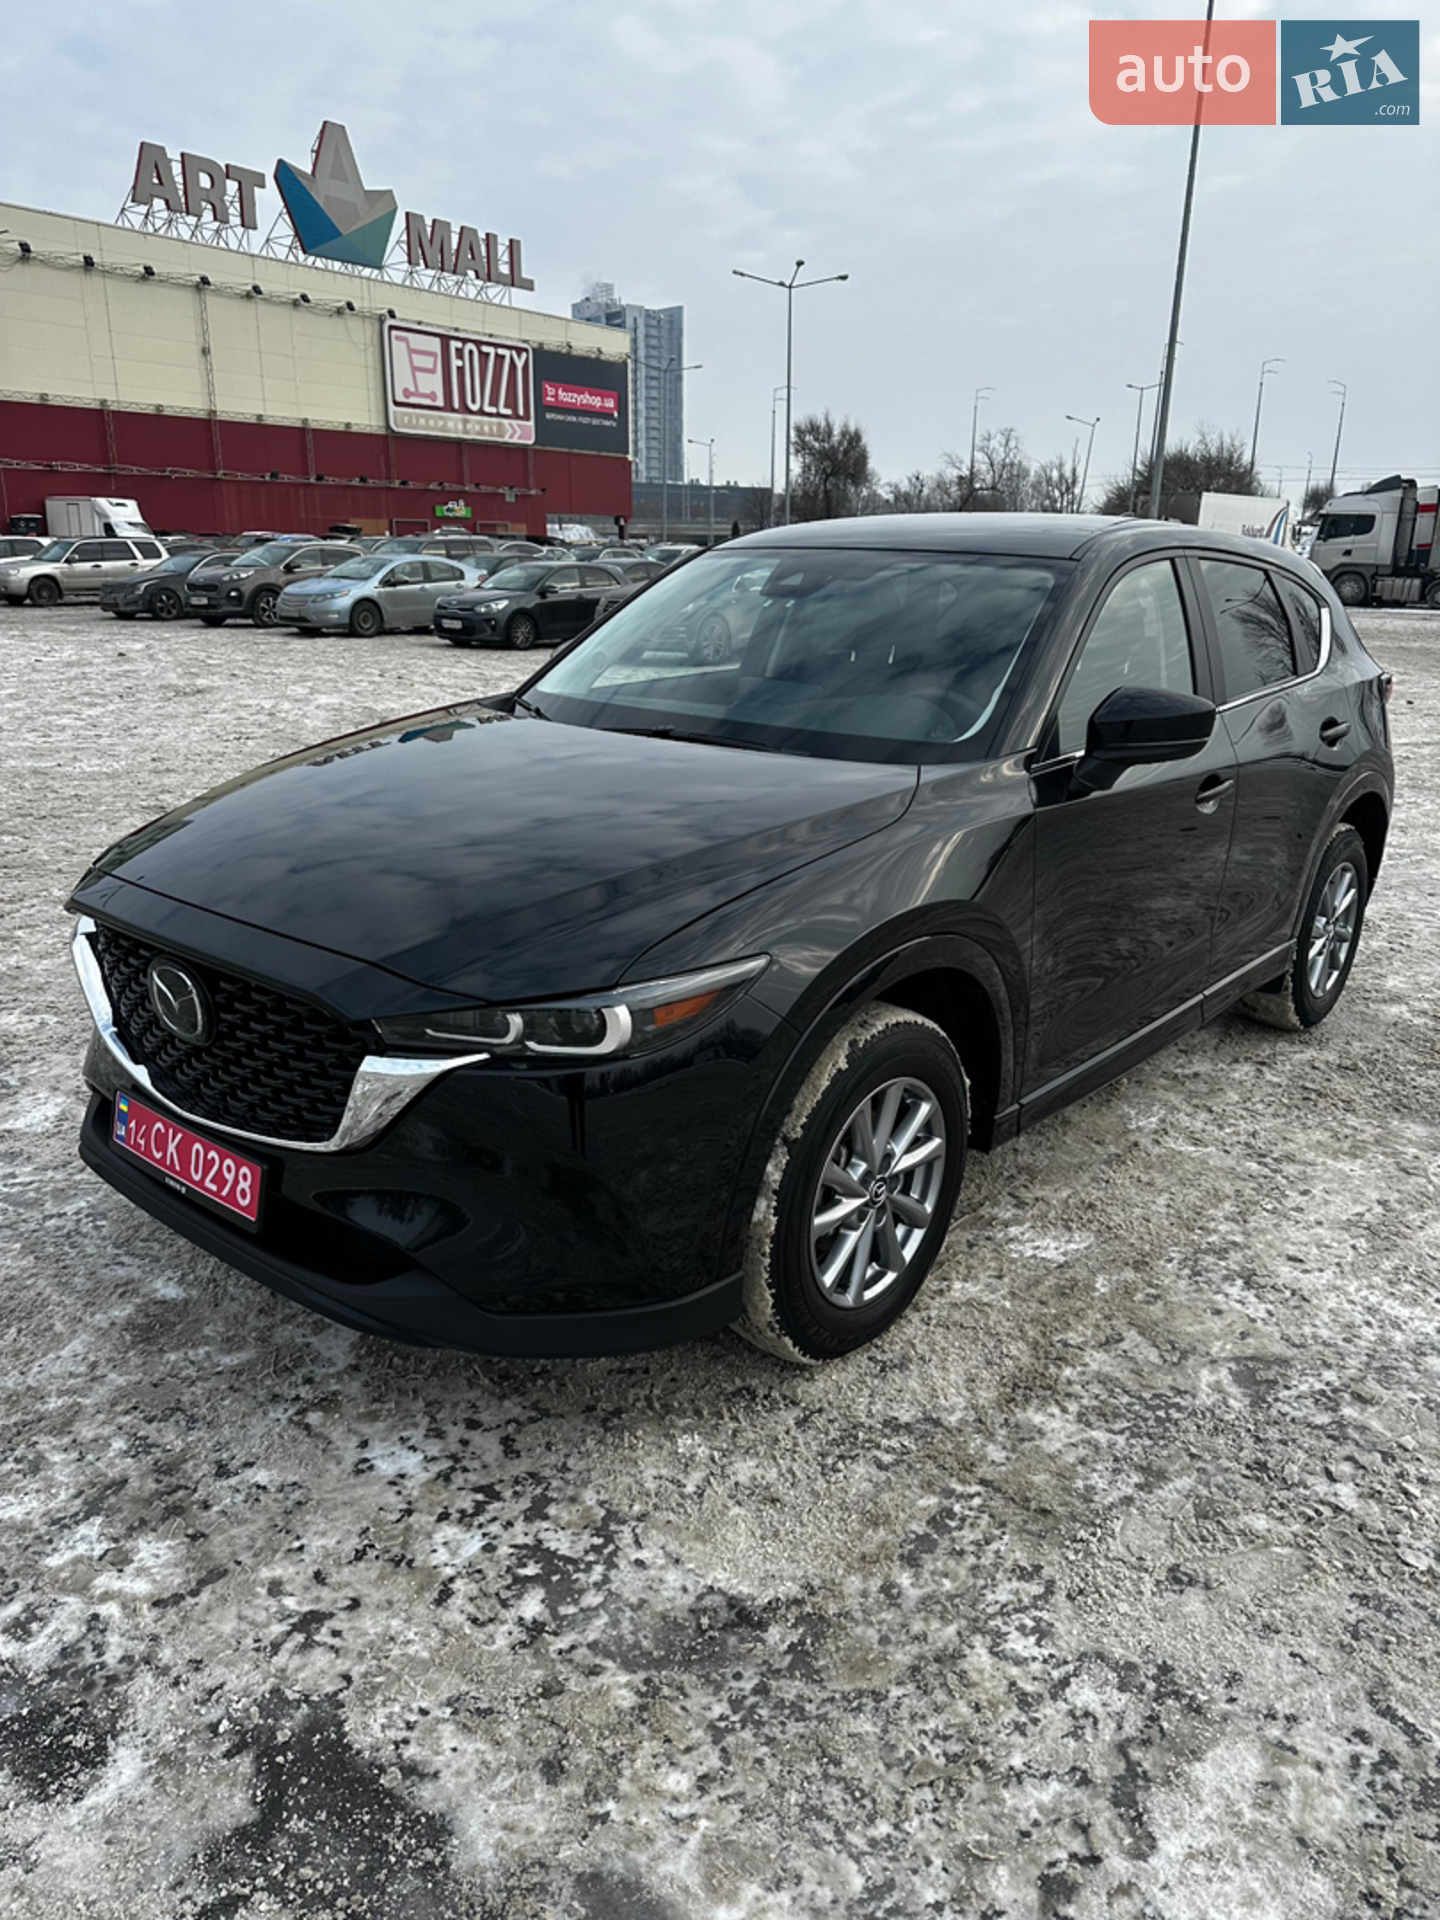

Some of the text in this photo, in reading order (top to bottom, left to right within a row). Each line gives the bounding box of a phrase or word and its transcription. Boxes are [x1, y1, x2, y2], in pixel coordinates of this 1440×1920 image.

[131, 141, 266, 230] ART
[405, 211, 535, 292] MALL
[448, 340, 527, 418] FOZZY
[557, 387, 615, 408] fozzyshop.ua
[189, 1142, 253, 1207] 0298
